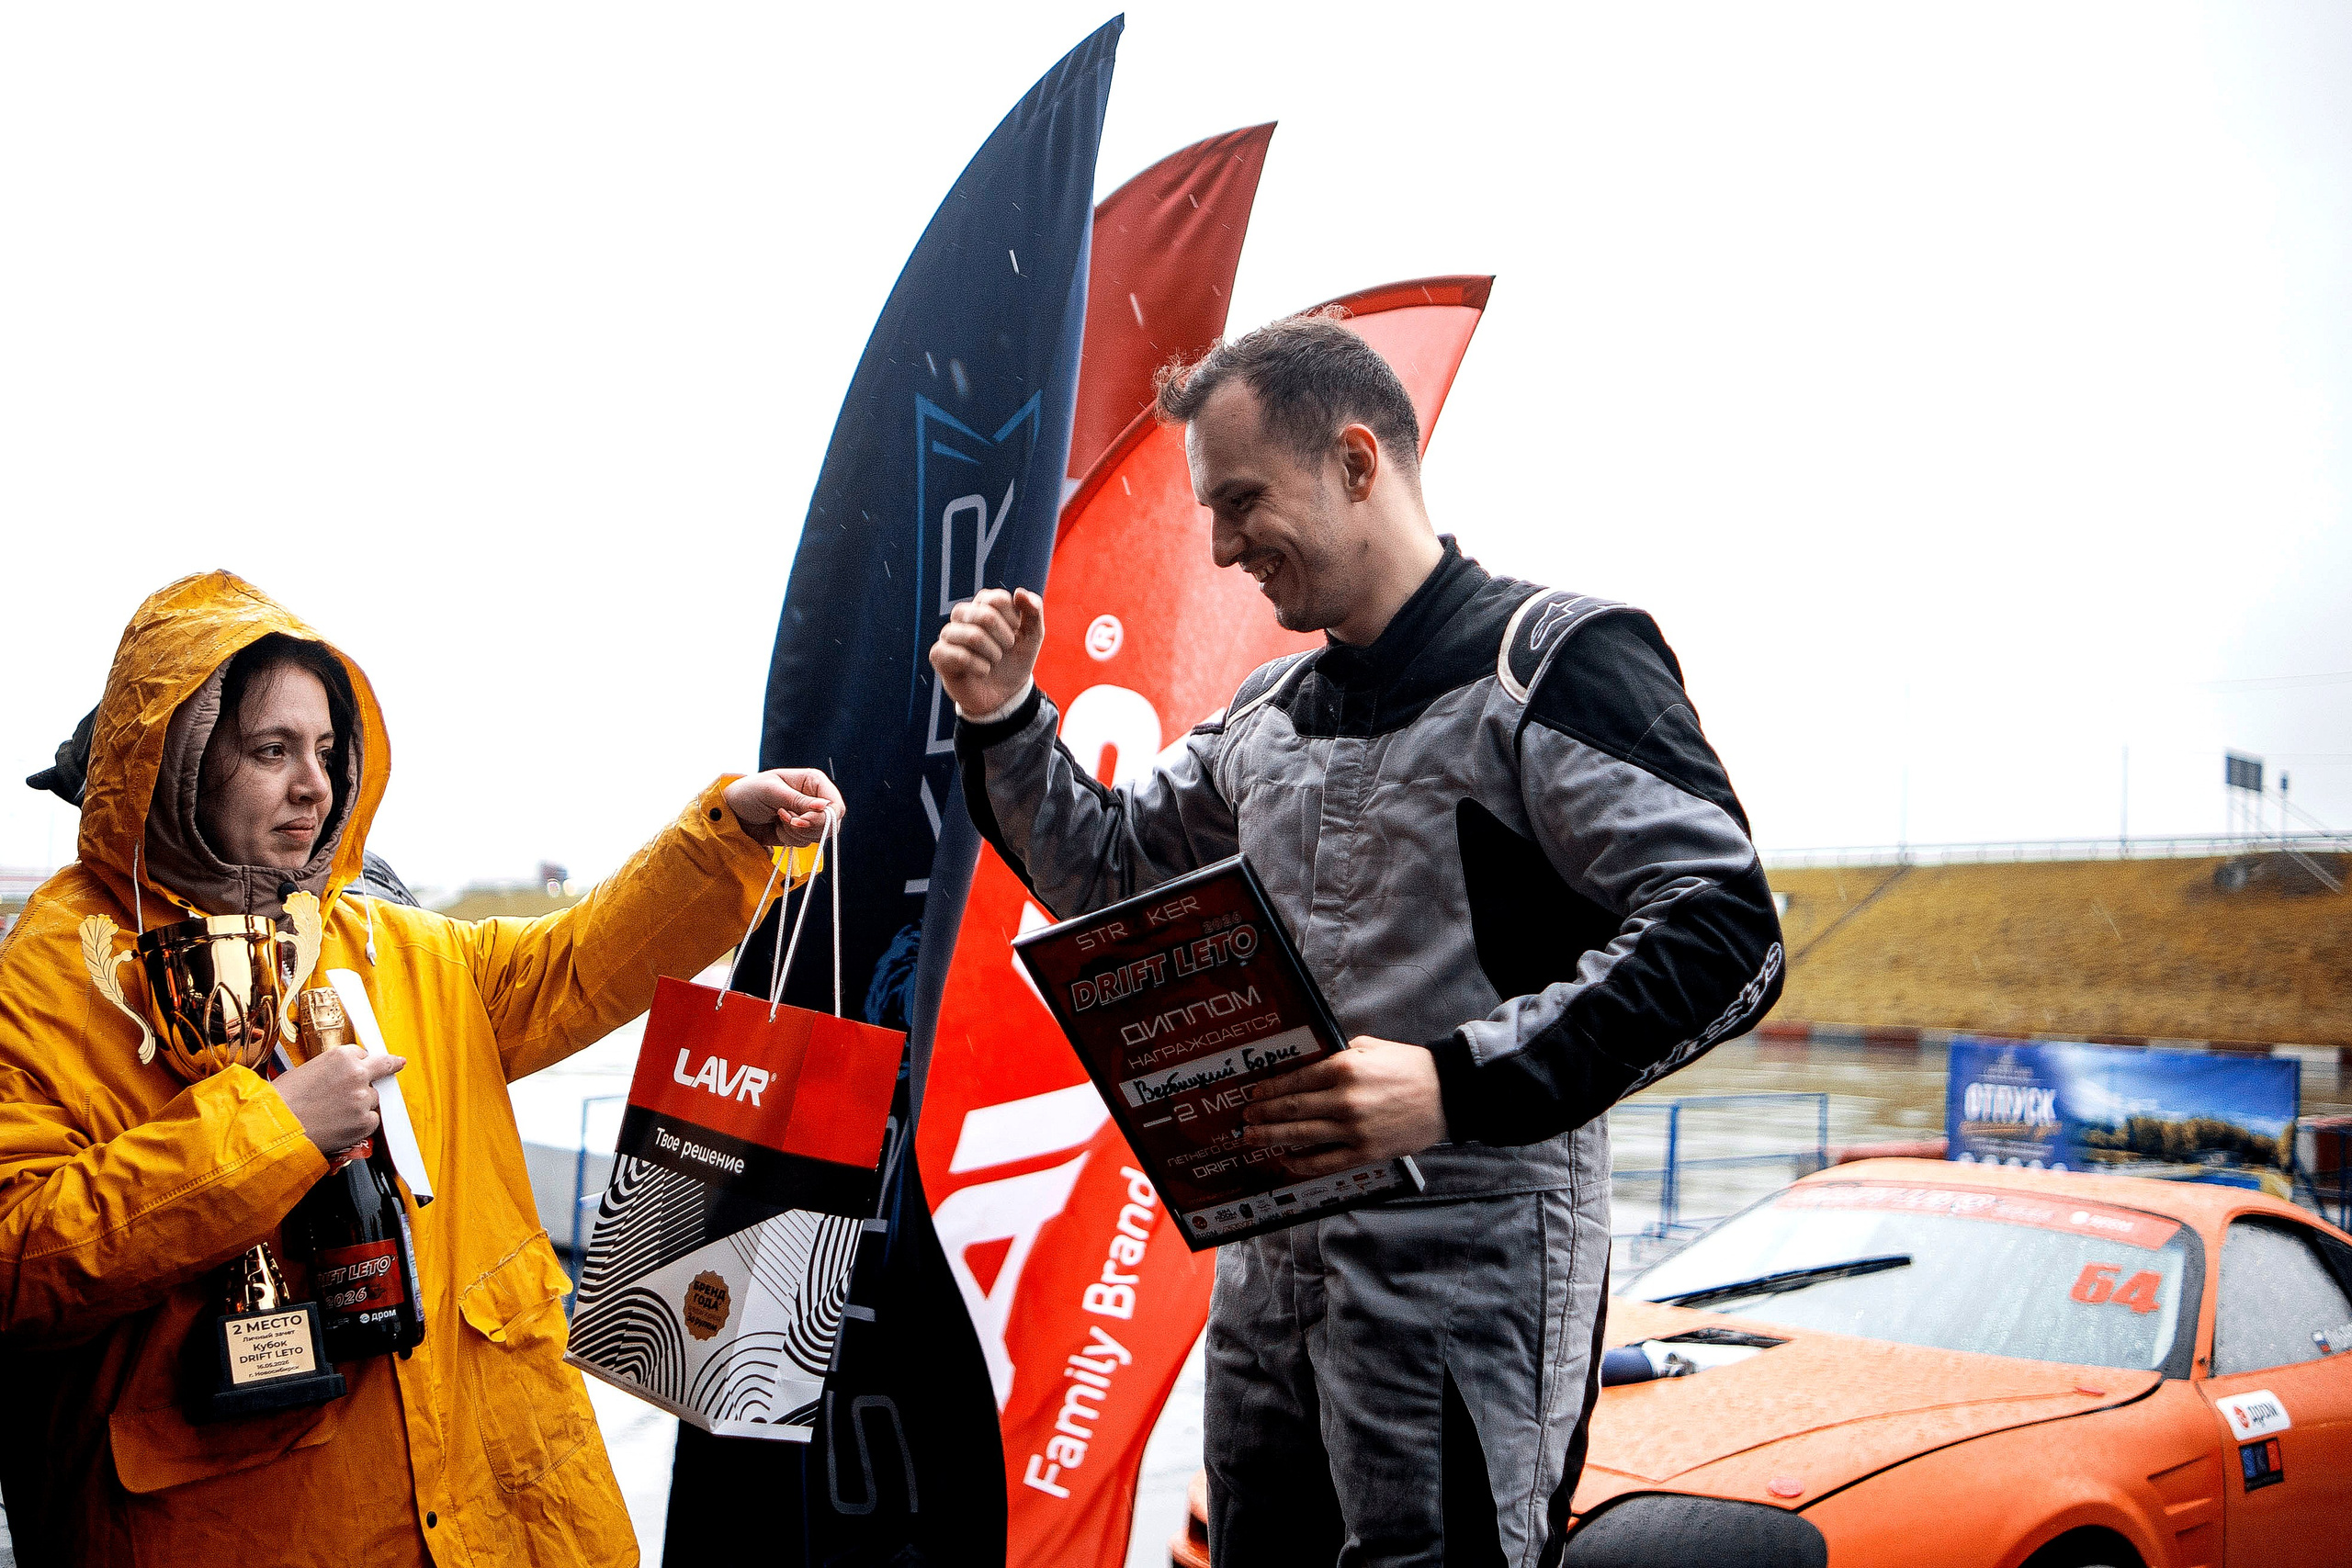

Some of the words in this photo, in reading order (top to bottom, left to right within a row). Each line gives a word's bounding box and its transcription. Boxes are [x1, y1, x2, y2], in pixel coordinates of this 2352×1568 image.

[1202, 911, 1243, 934] 2026
[1070, 952, 1167, 1013] DRIFT
[1172, 922, 1260, 978] LETO
[1120, 985, 1262, 1047] ДИПЛОМ
[1127, 1011, 1282, 1070] НАГРАЖДАЕТСЯ
[1241, 1043, 1301, 1078] Борис
[1173, 1102, 1199, 1123] 2
[1200, 1082, 1259, 1115] МЕС
[655, 1126, 681, 1152] Твое
[680, 1140, 745, 1174] решение
[1191, 1156, 1238, 1179] DRIFT
[1241, 1144, 1286, 1165] LETO
[348, 1254, 392, 1281] LETO
[324, 1286, 368, 1310] 2026
[693, 1280, 727, 1303] БРЕНД
[2068, 1261, 2164, 1315] 64
[232, 1324, 243, 1336] 2
[246, 1314, 302, 1334] МЕСТО
[371, 1308, 397, 1323] дром
[243, 1332, 274, 1343] Личный
[253, 1339, 288, 1352] Кубок
[1022, 1324, 1134, 1500] Family
[1081, 1165, 1159, 1321] Brand
[239, 1350, 273, 1364] DRIFT
[275, 1346, 304, 1359] LETO
[254, 1365, 300, 1377] Новосибирск
